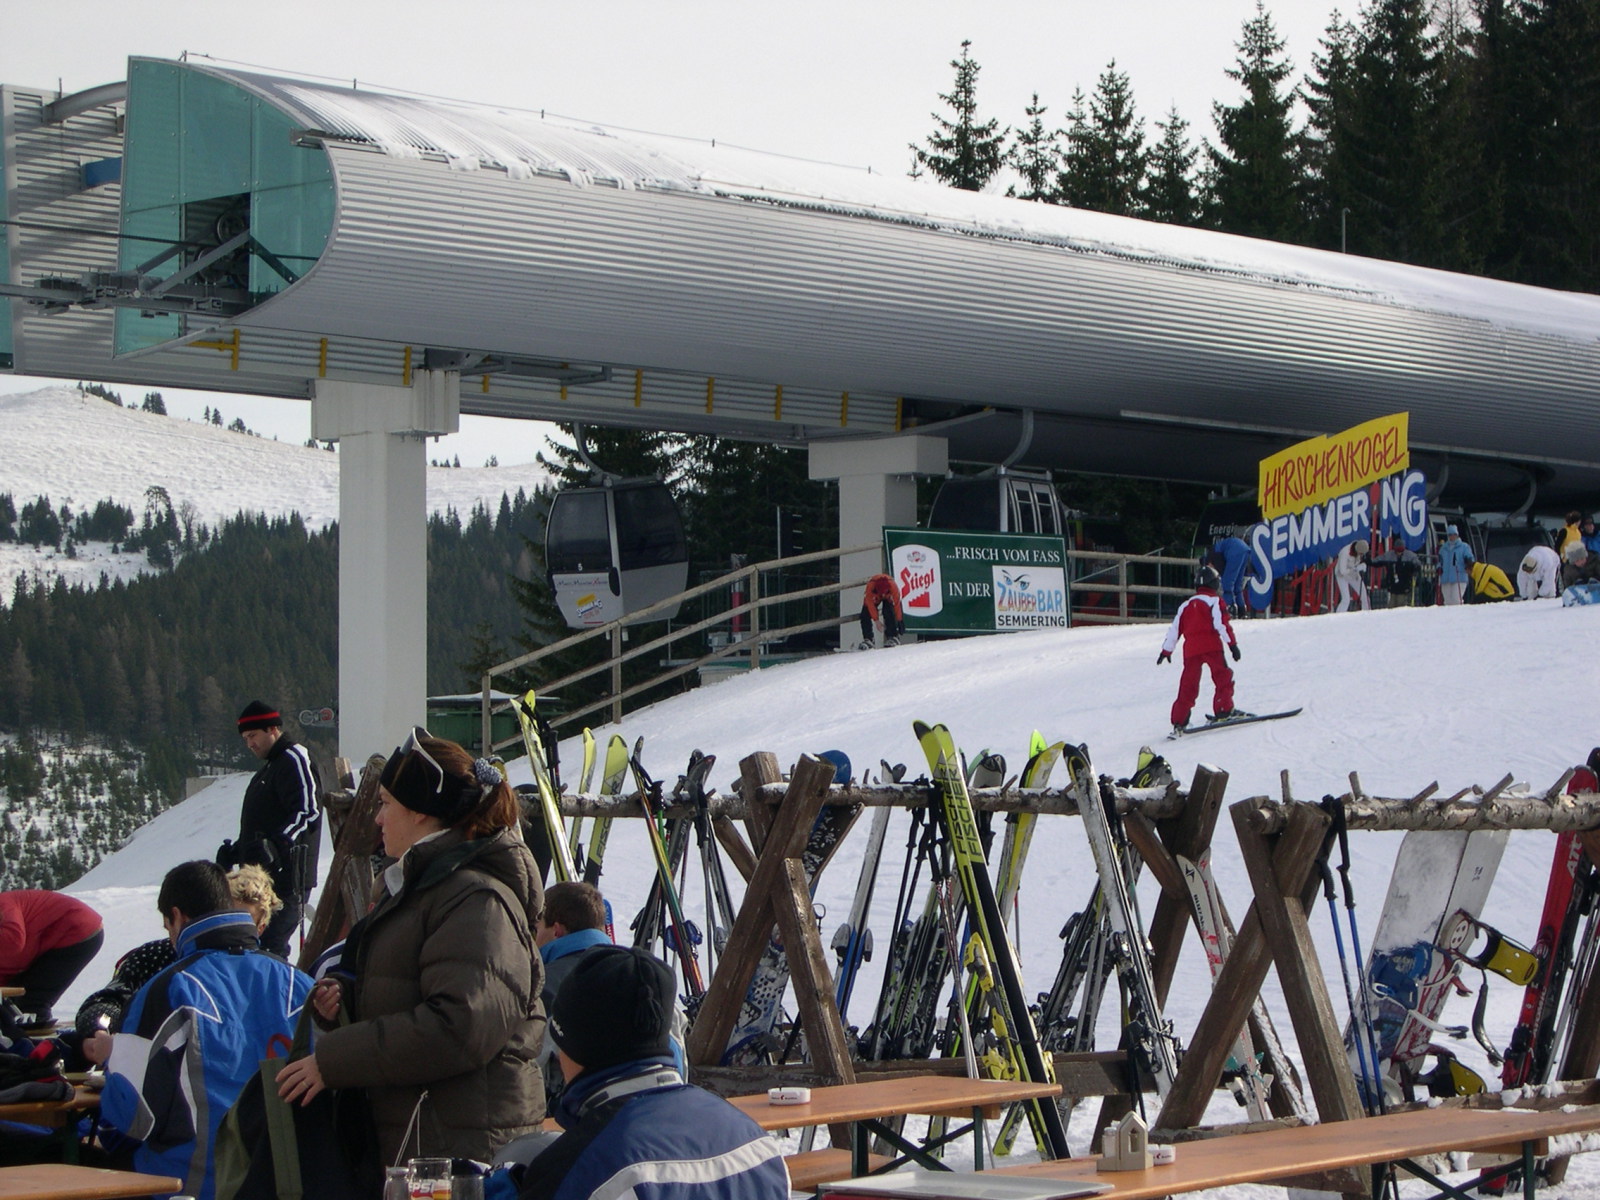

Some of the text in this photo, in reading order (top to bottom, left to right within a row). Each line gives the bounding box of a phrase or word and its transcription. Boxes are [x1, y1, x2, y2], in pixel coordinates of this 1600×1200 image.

[1263, 426, 1405, 512] HIRSCHENKOGEL
[1002, 549, 1030, 562] VOM
[1033, 550, 1060, 563] FASS
[900, 566, 935, 599] Stiegl
[949, 582, 991, 597] IN DER
[997, 615, 1065, 627] SEMMERING
[948, 767, 982, 857] FISCHER
